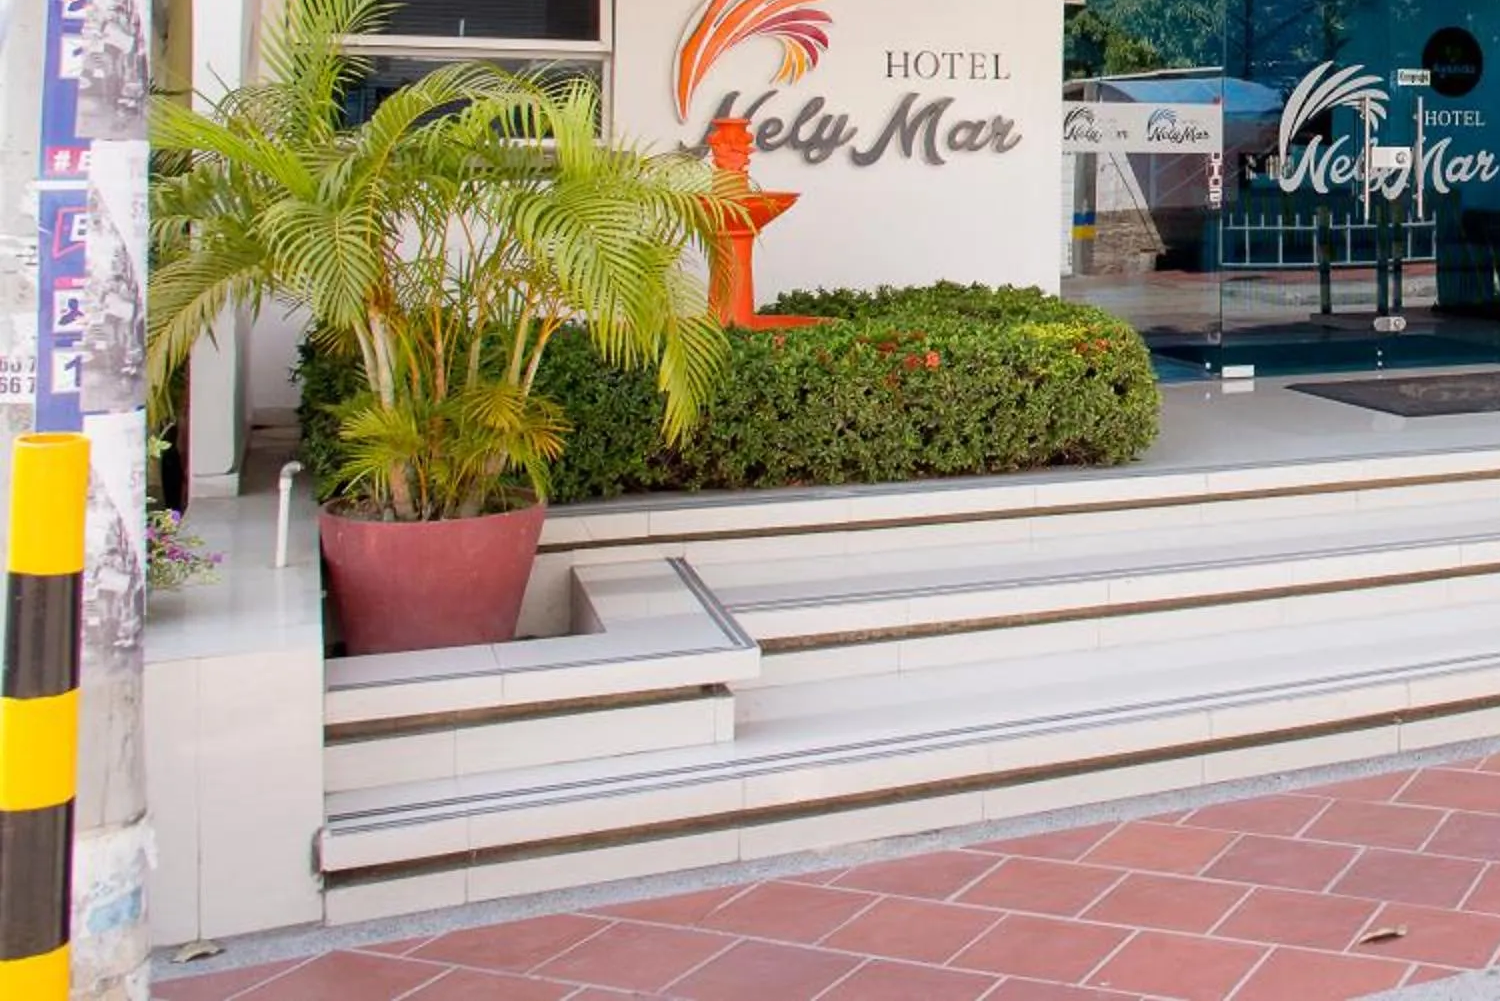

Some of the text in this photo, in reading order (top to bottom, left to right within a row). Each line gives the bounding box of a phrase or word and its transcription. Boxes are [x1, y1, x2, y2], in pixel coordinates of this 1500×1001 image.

[885, 51, 1011, 80] HOTEL
[850, 92, 1023, 166] Mar
[1424, 110, 1486, 126] HOTEL
